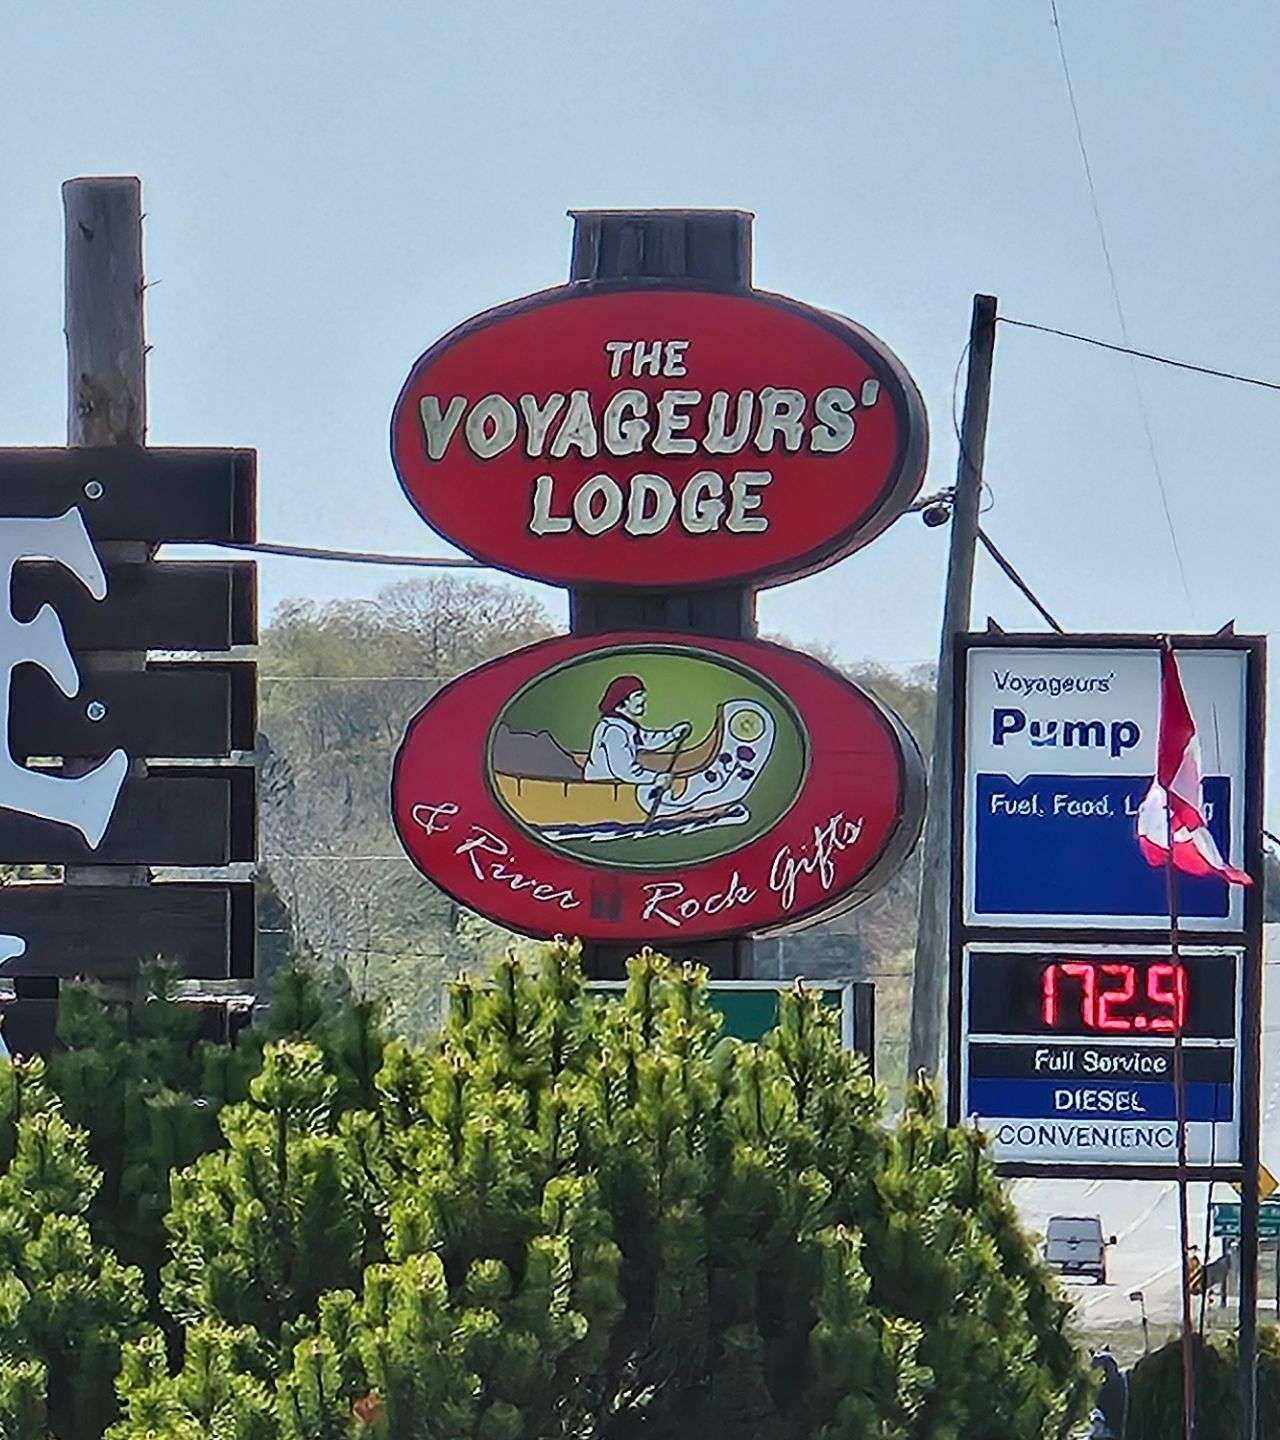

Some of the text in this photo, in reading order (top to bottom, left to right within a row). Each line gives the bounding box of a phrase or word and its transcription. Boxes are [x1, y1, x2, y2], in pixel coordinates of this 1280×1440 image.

[605, 340, 690, 379] THE
[419, 379, 880, 460] VOYAGEURS'
[528, 470, 774, 536] LODGE
[994, 669, 1116, 696] Voyageurs'
[991, 707, 1142, 757] Pump
[455, 826, 585, 910] River
[640, 872, 759, 928] Rock
[768, 811, 865, 910] Gifts
[1034, 1049, 1168, 1074] Full Service
[1053, 1088, 1147, 1113] DIESEL
[997, 1124, 1183, 1149] CONVENIENC
